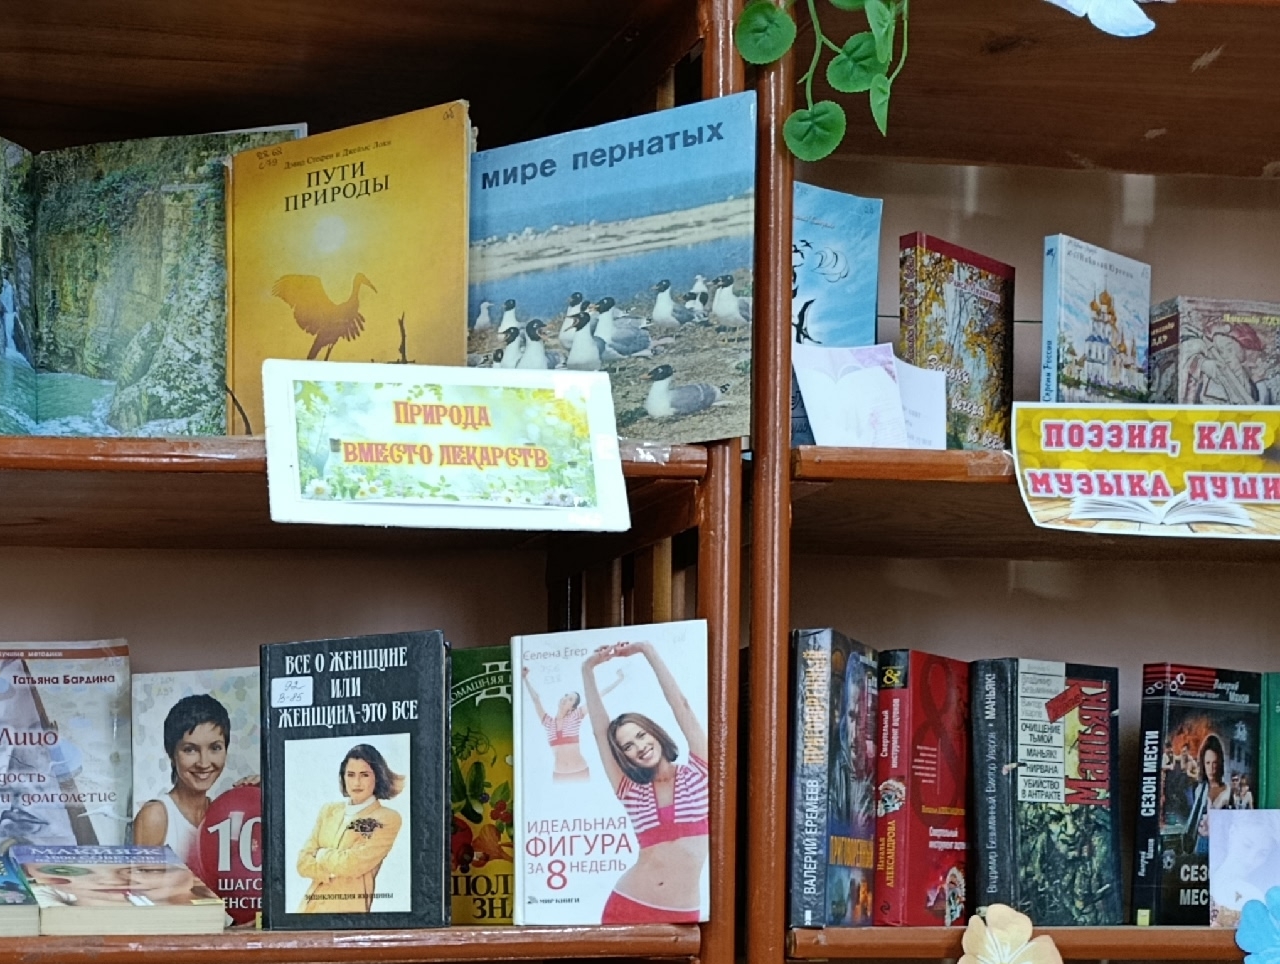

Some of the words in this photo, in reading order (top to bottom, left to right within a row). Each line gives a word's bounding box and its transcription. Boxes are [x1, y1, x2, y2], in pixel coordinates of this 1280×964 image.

[481, 158, 557, 190] мире
[572, 119, 725, 172] пернатых
[306, 160, 365, 188] ПУТИ
[284, 174, 391, 212] ПРИРОДЫ
[1043, 422, 1179, 454] ПОЭЗИЯ,
[1196, 424, 1263, 451] КАК
[343, 442, 433, 464] ВМЕСТО
[439, 443, 549, 470] ЛЕКАРСТВ
[1028, 472, 1172, 498] МУЗЫКА
[1188, 474, 1280, 501] ДУШИ
[285, 655, 311, 675] ВСЕ
[329, 647, 408, 673] ЖЕНЩИНЕ
[564, 646, 588, 660] Егер
[13, 675, 59, 685] Татьяна
[63, 674, 115, 685] Бардина
[330, 677, 361, 698] ИЛИ
[392, 700, 418, 721] ВСЕ
[1143, 730, 1159, 771] МЕСТИ
[1023, 777, 1060, 790] УБИЙСТВО
[1028, 790, 1061, 801] АНТРАКТЕ
[1140, 771, 1157, 817] СЕЗОН
[1, 793, 10, 803] и
[21, 791, 117, 806] долголетие
[805, 779, 819, 834] ЕРЕМЕЕВ
[527, 816, 627, 834] ИДЕАЛЬНАЯ
[525, 833, 632, 857] ФИГУРА
[546, 859, 568, 890] 8
[570, 860, 627, 874] НЕДЕЛЬ
[804, 837, 817, 895] ВАЛЕРИЙ
